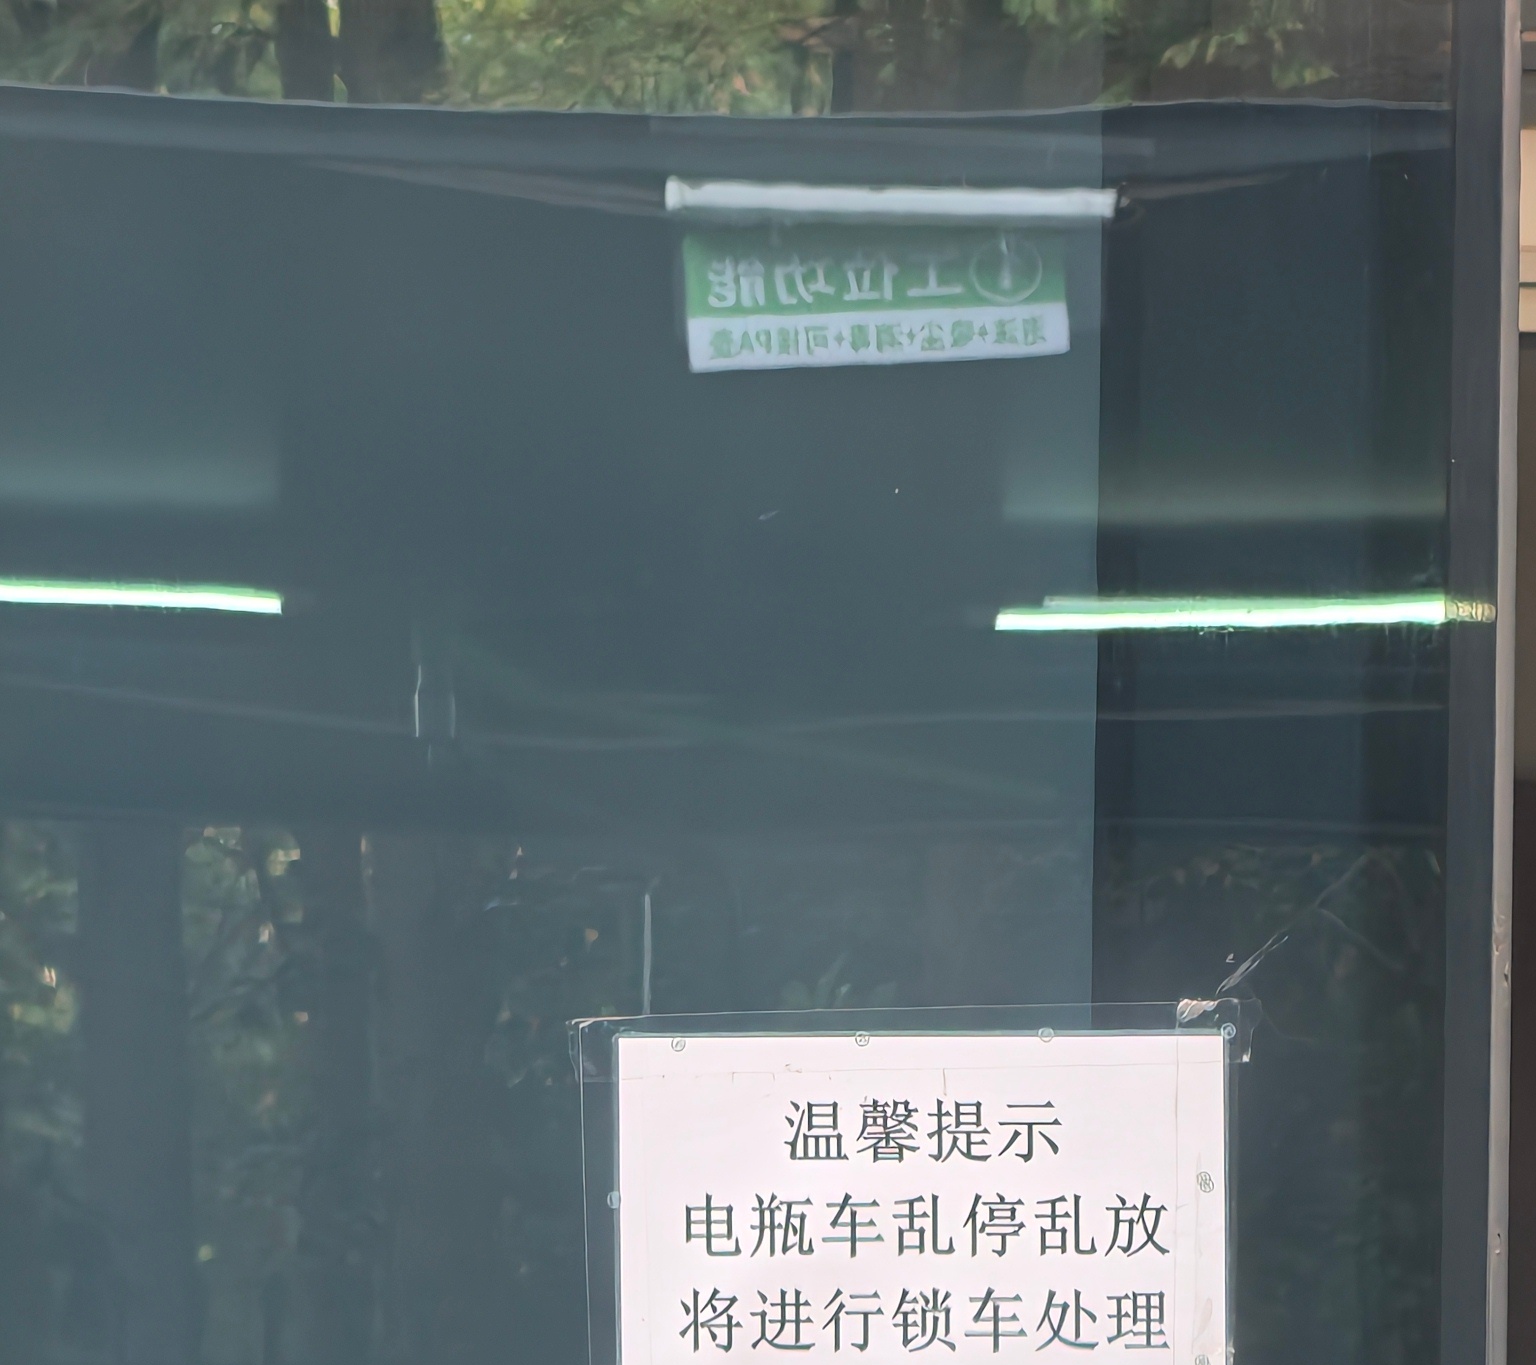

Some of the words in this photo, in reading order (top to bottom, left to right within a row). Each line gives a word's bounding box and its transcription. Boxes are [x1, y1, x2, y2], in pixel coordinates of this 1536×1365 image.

[784, 1097, 1062, 1163] 温馨提示
[685, 1192, 1171, 1258] 电瓶车乱停乱放
[680, 1287, 1171, 1353] 将进行锁车处理
